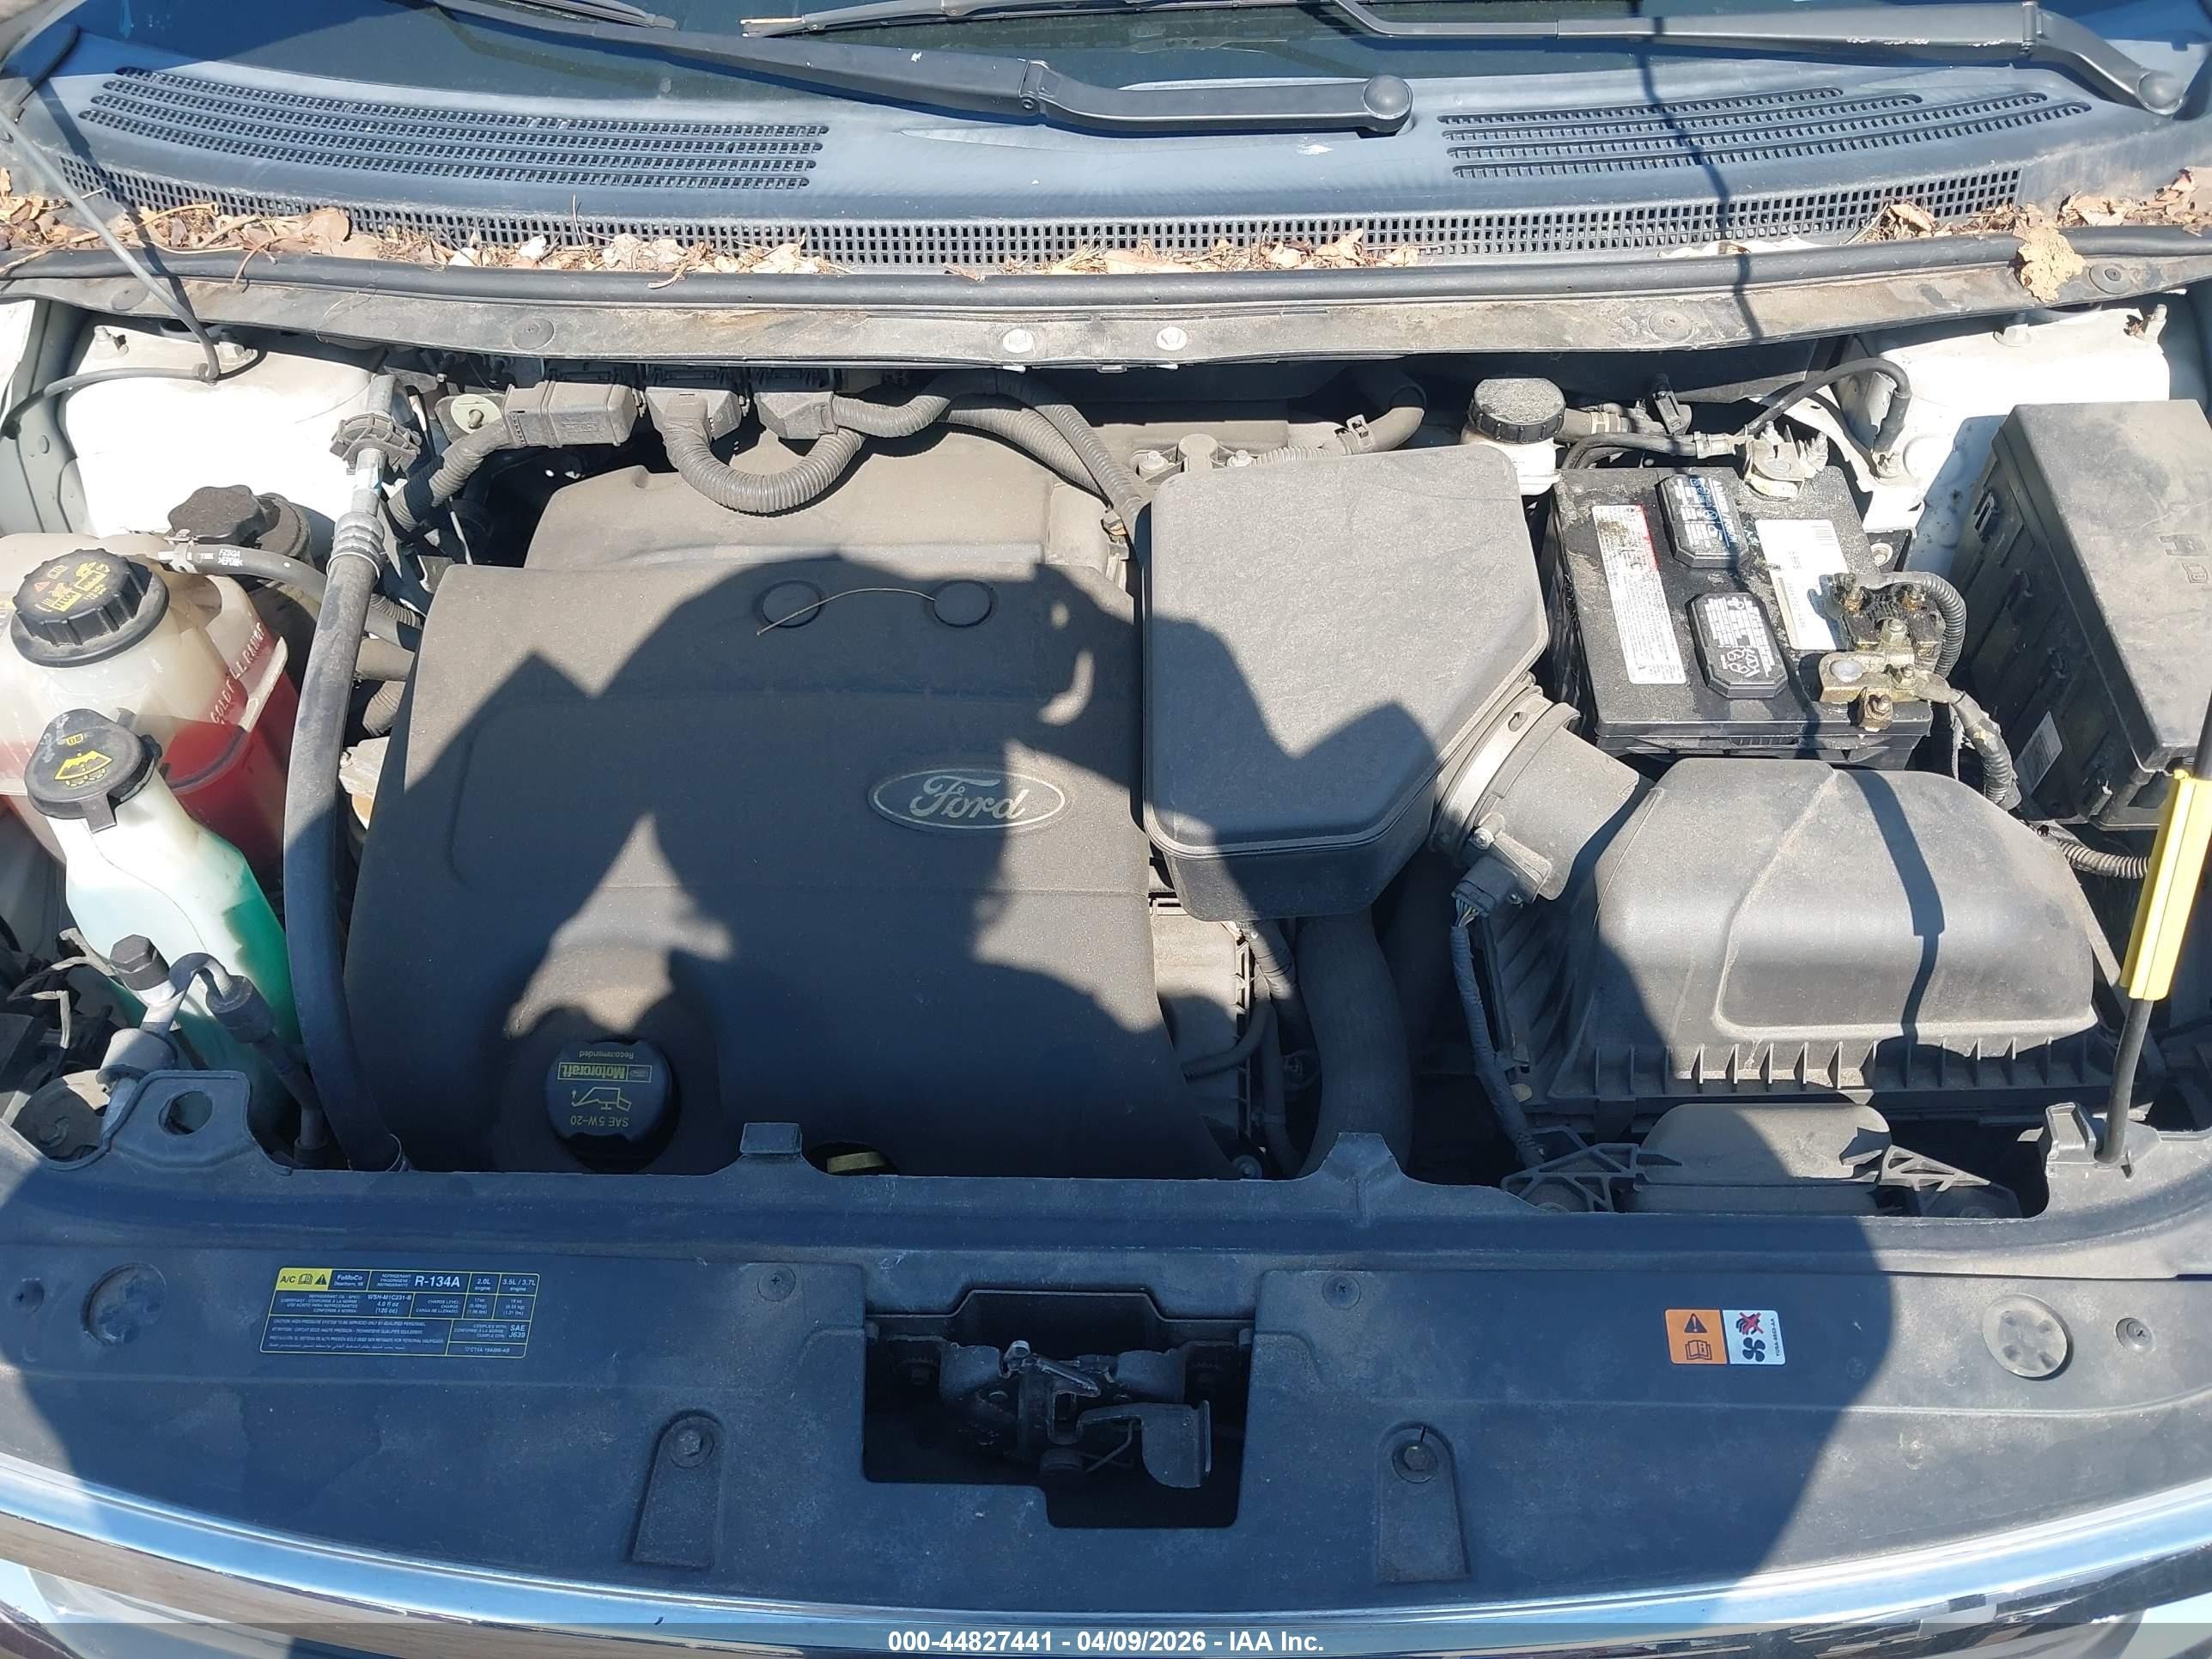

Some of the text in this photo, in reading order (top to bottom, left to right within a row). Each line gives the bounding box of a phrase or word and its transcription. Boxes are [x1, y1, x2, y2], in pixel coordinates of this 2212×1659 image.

[909, 775, 1030, 820] Ford
[579, 1050, 634, 1059] Recommended
[562, 1065, 626, 1079] Motorcraft
[570, 1115, 629, 1127] SAE 5W-20
[414, 1275, 460, 1287] R-134A
